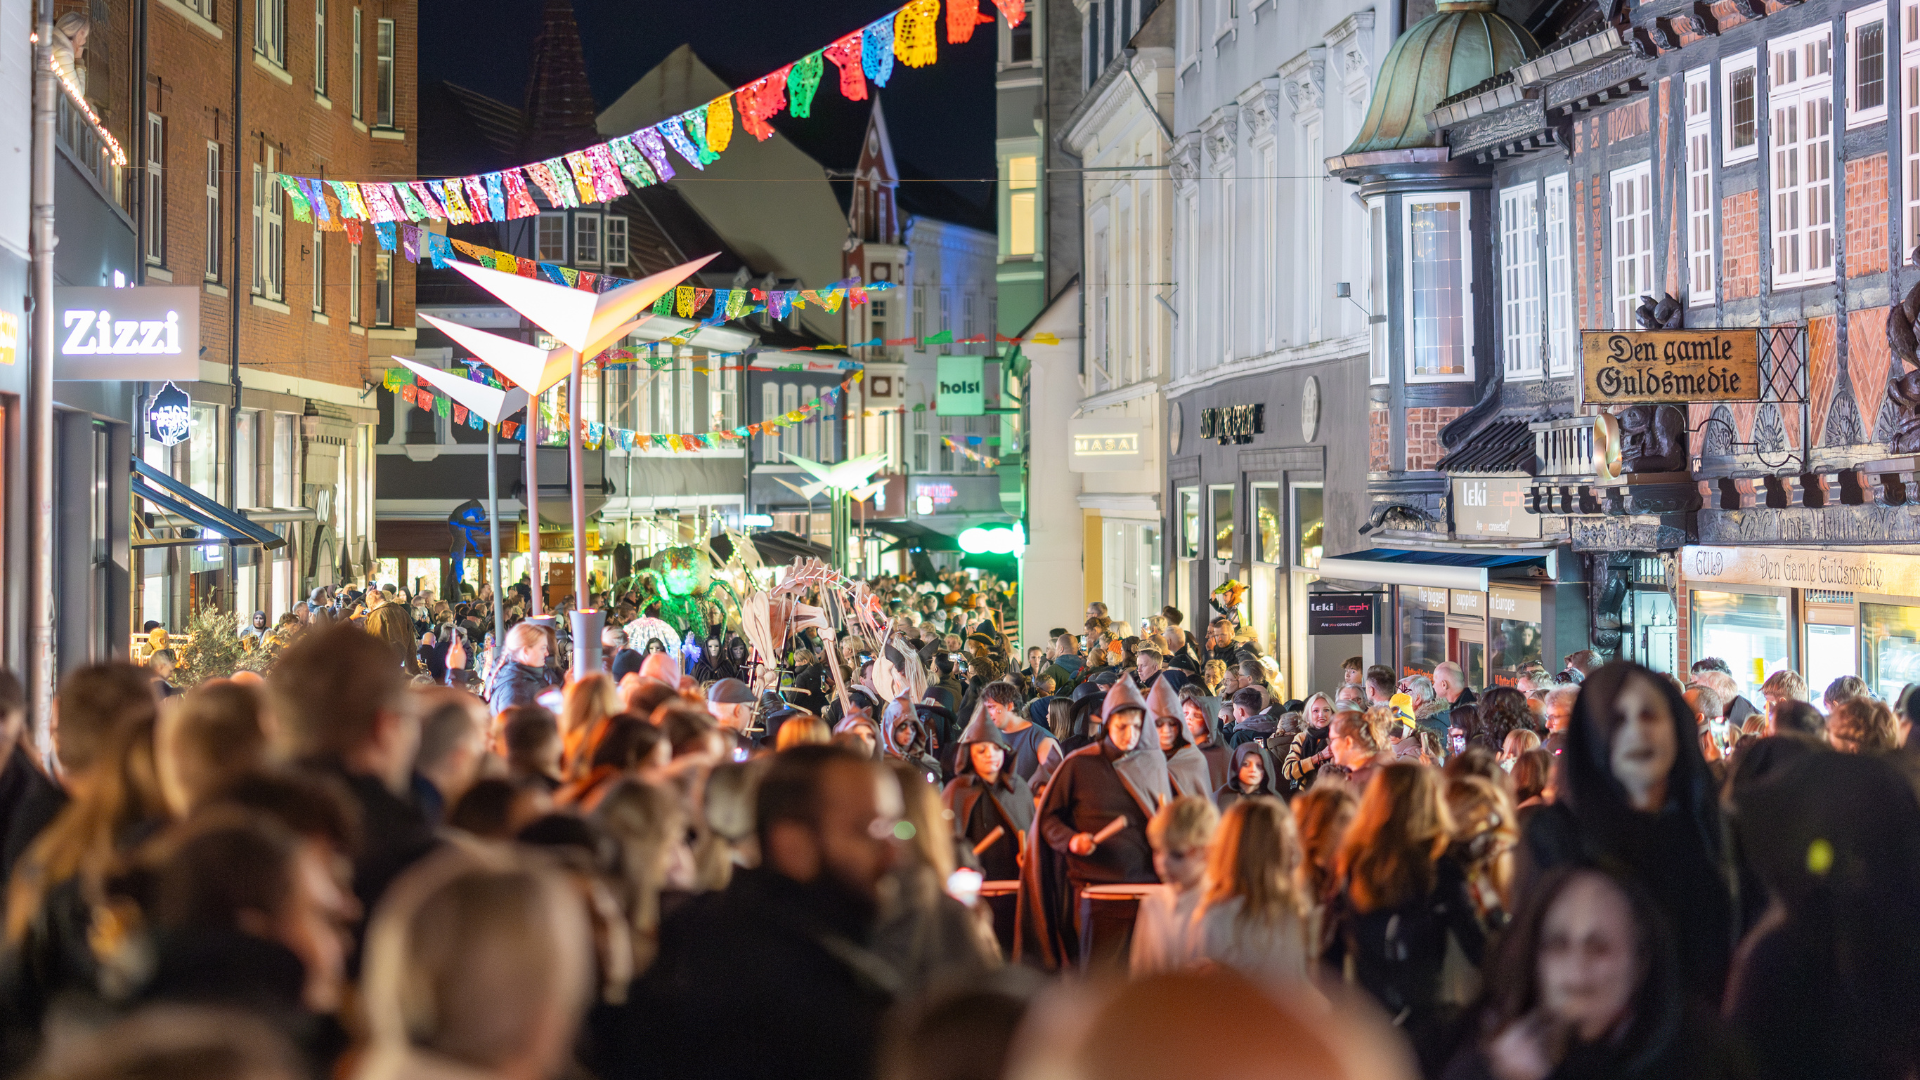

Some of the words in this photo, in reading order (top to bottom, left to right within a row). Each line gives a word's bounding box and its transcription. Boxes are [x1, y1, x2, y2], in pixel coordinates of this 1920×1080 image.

[62, 310, 181, 354] Zizzi
[1607, 335, 1657, 363] Den
[1664, 335, 1731, 365] gamle
[1596, 366, 1740, 396] Guldsmedie
[1075, 437, 1138, 451] MASAI
[1696, 551, 1724, 576] GULD
[1760, 554, 1780, 580] Den
[1784, 554, 1816, 585] Gamle
[1819, 555, 1882, 588] Guldsmedie
[1418, 587, 1427, 602] The
[1456, 591, 1477, 610] supplier
[1489, 594, 1495, 609] in
[1495, 594, 1515, 615] Europe
